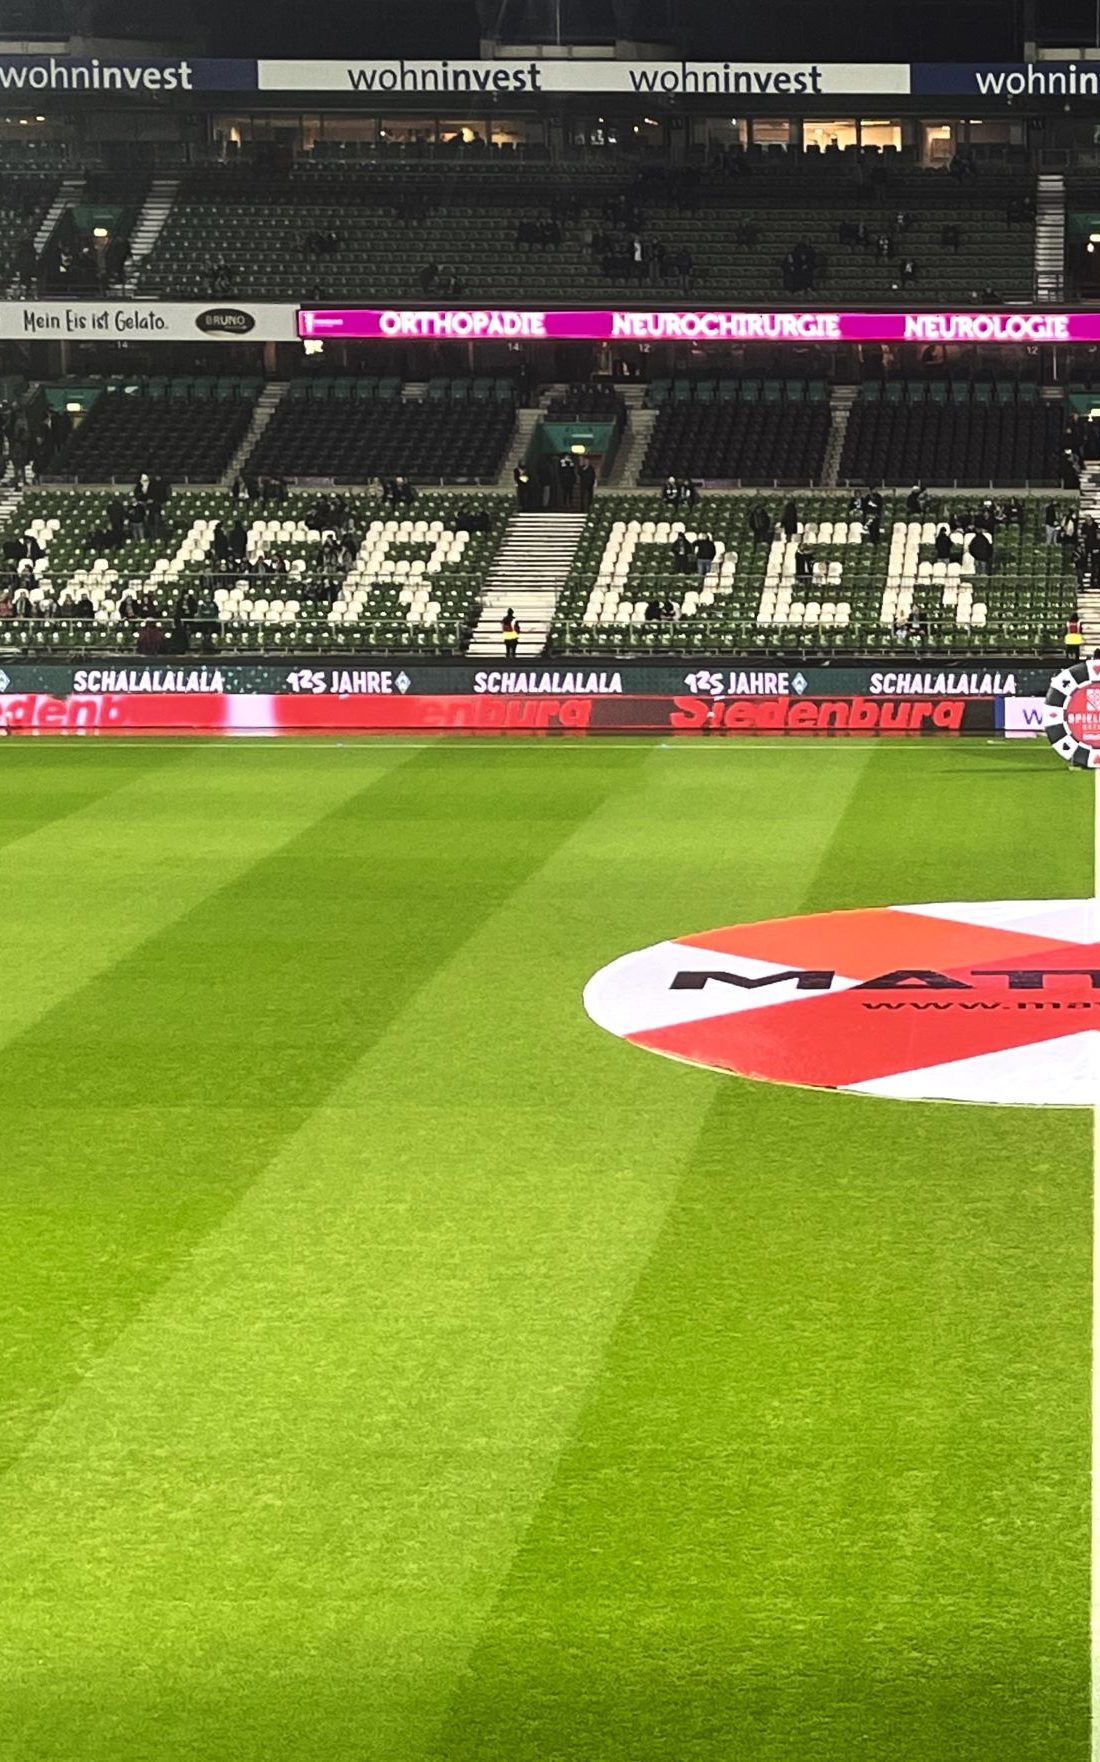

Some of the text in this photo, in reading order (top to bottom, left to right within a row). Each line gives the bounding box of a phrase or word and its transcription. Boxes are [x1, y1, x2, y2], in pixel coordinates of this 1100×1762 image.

[0, 58, 193, 90] wohninvest
[347, 61, 541, 91] wohninvest
[629, 63, 823, 94] wohninvest
[23, 309, 61, 333] Mein
[66, 309, 87, 331] Eis
[91, 310, 110, 330] ist
[612, 313, 841, 337] NEUROCHIRURGIE
[904, 315, 1070, 338] NEUROLOGIE
[330, 671, 393, 693] JAHRE
[727, 672, 789, 694] JAHRE
[670, 696, 965, 728] Siedenburg
